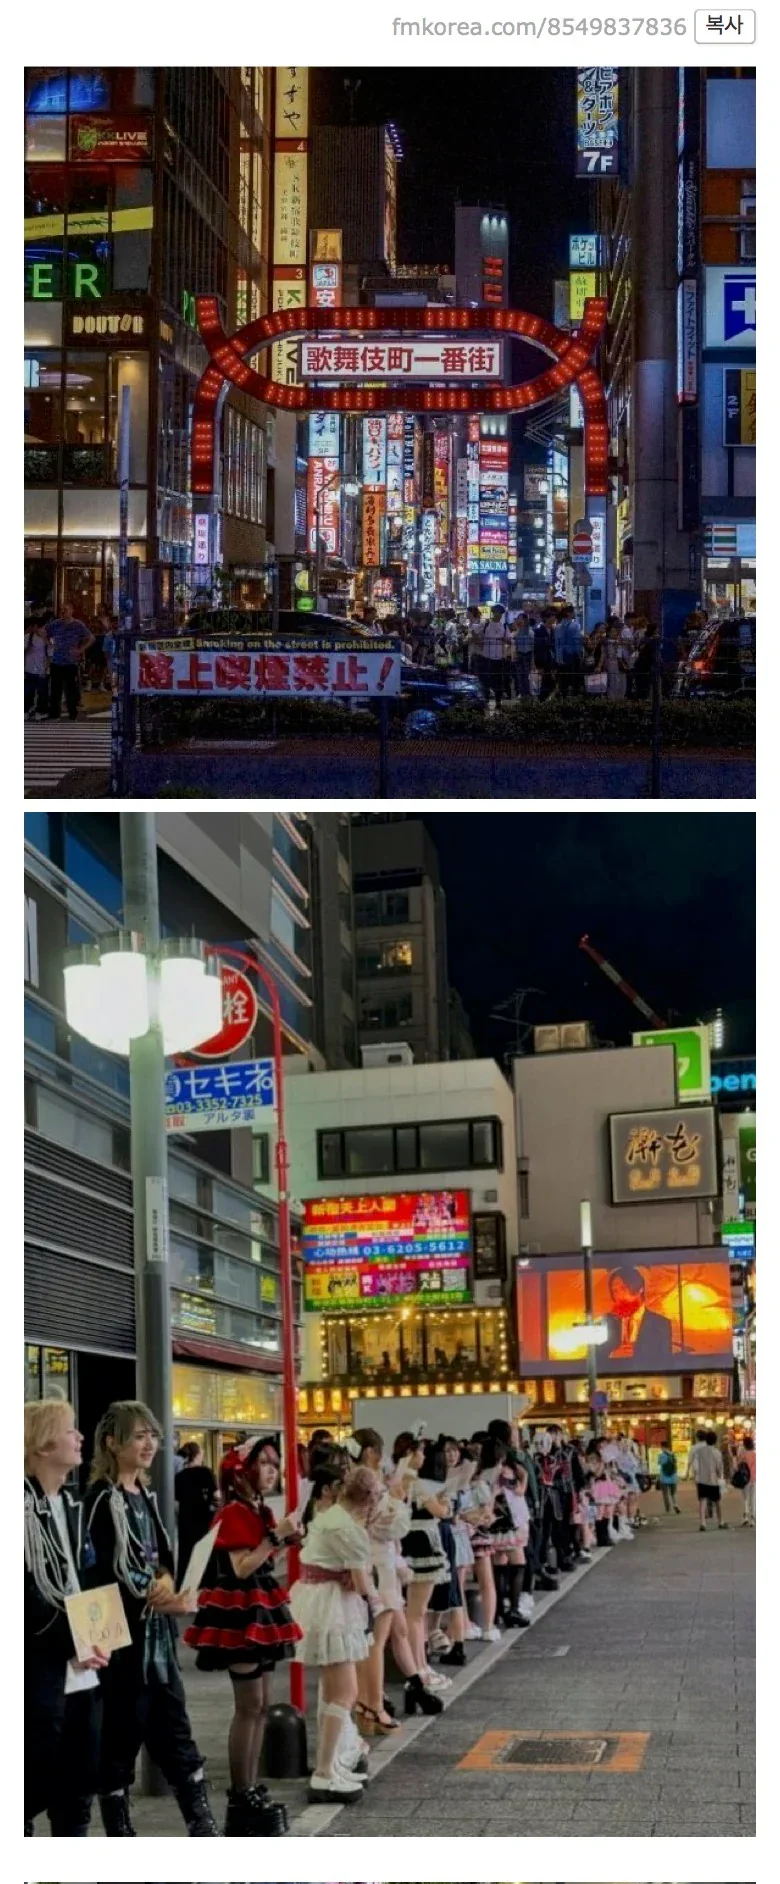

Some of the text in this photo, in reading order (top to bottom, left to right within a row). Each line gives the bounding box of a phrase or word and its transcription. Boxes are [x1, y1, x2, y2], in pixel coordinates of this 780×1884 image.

[583, 152, 612, 172] 7F
[295, 268, 303, 280] 3
[72, 313, 144, 334] DOUTOR
[306, 346, 496, 374] 歌舞伎町一番街
[247, 641, 263, 649] on
[138, 654, 395, 691] 路上喫煙禁止！
[185, 1064, 273, 1099] セキネ
[363, 1241, 466, 1256] 03-6205-5612
